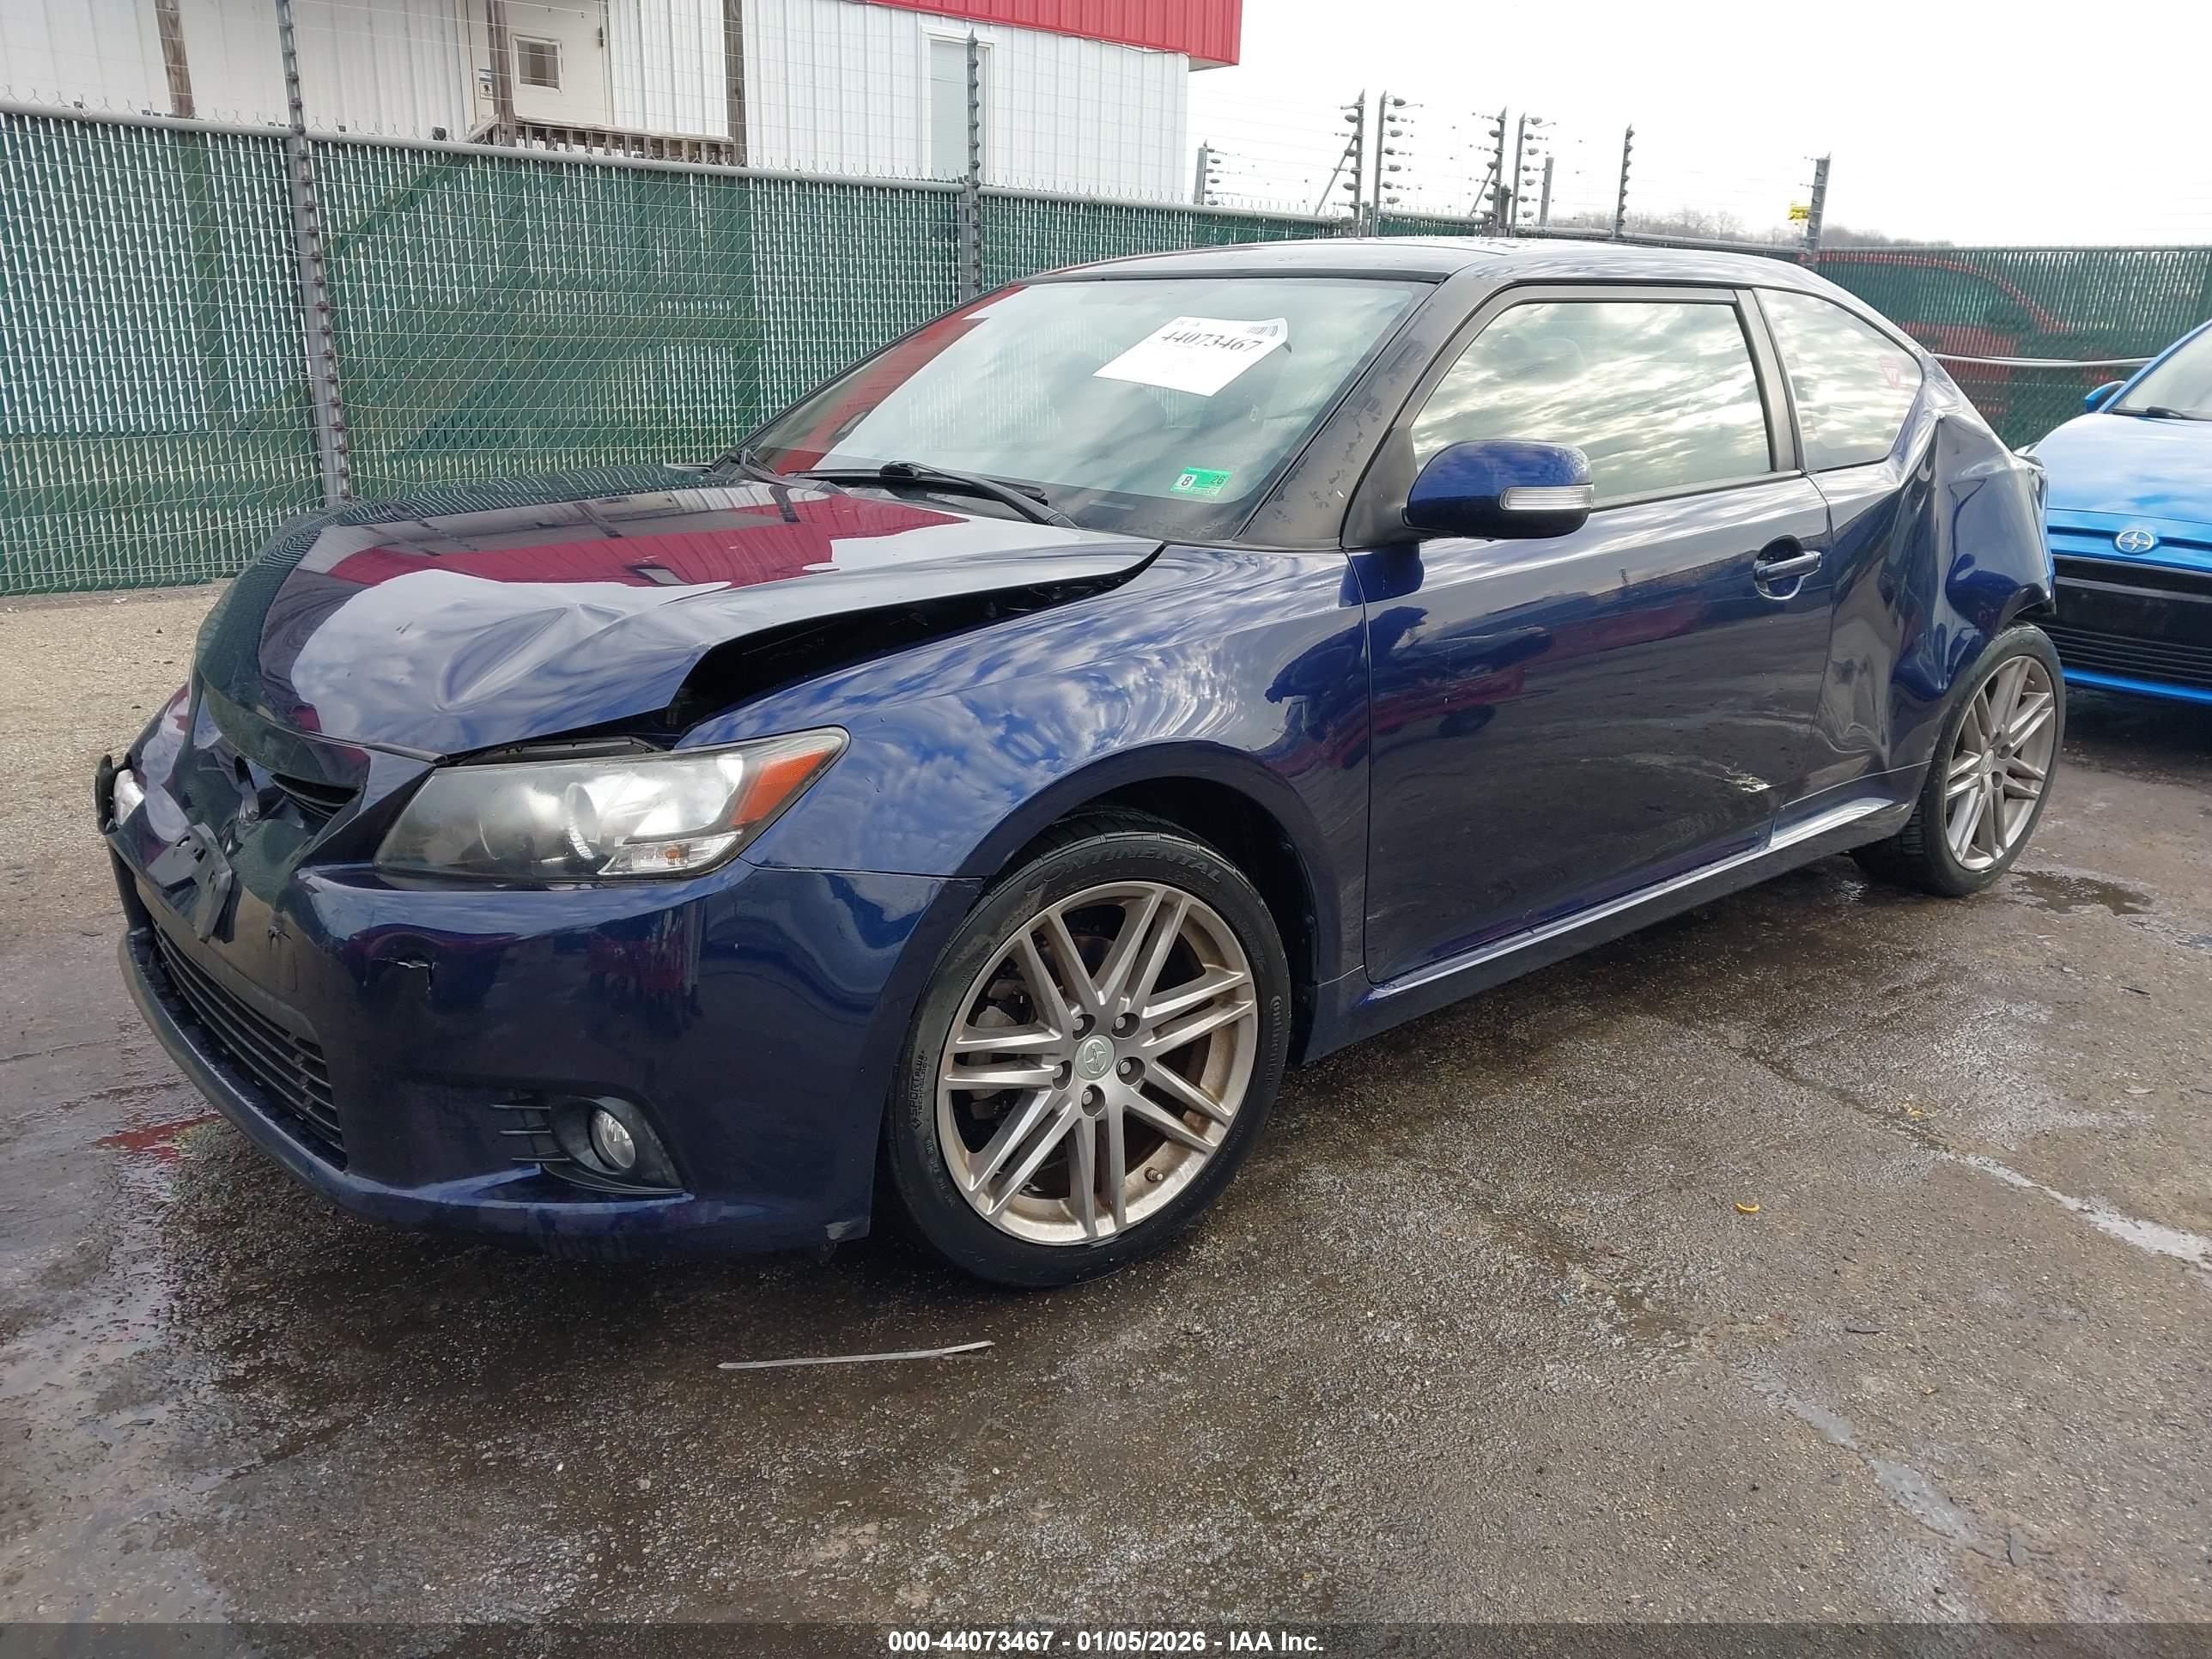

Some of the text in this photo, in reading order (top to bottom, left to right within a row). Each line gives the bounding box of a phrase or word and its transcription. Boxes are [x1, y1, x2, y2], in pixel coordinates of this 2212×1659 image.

[1162, 331, 1264, 352] 44073467
[1182, 477, 1193, 486] 8
[1024, 845, 1220, 893] CONTINENTAL
